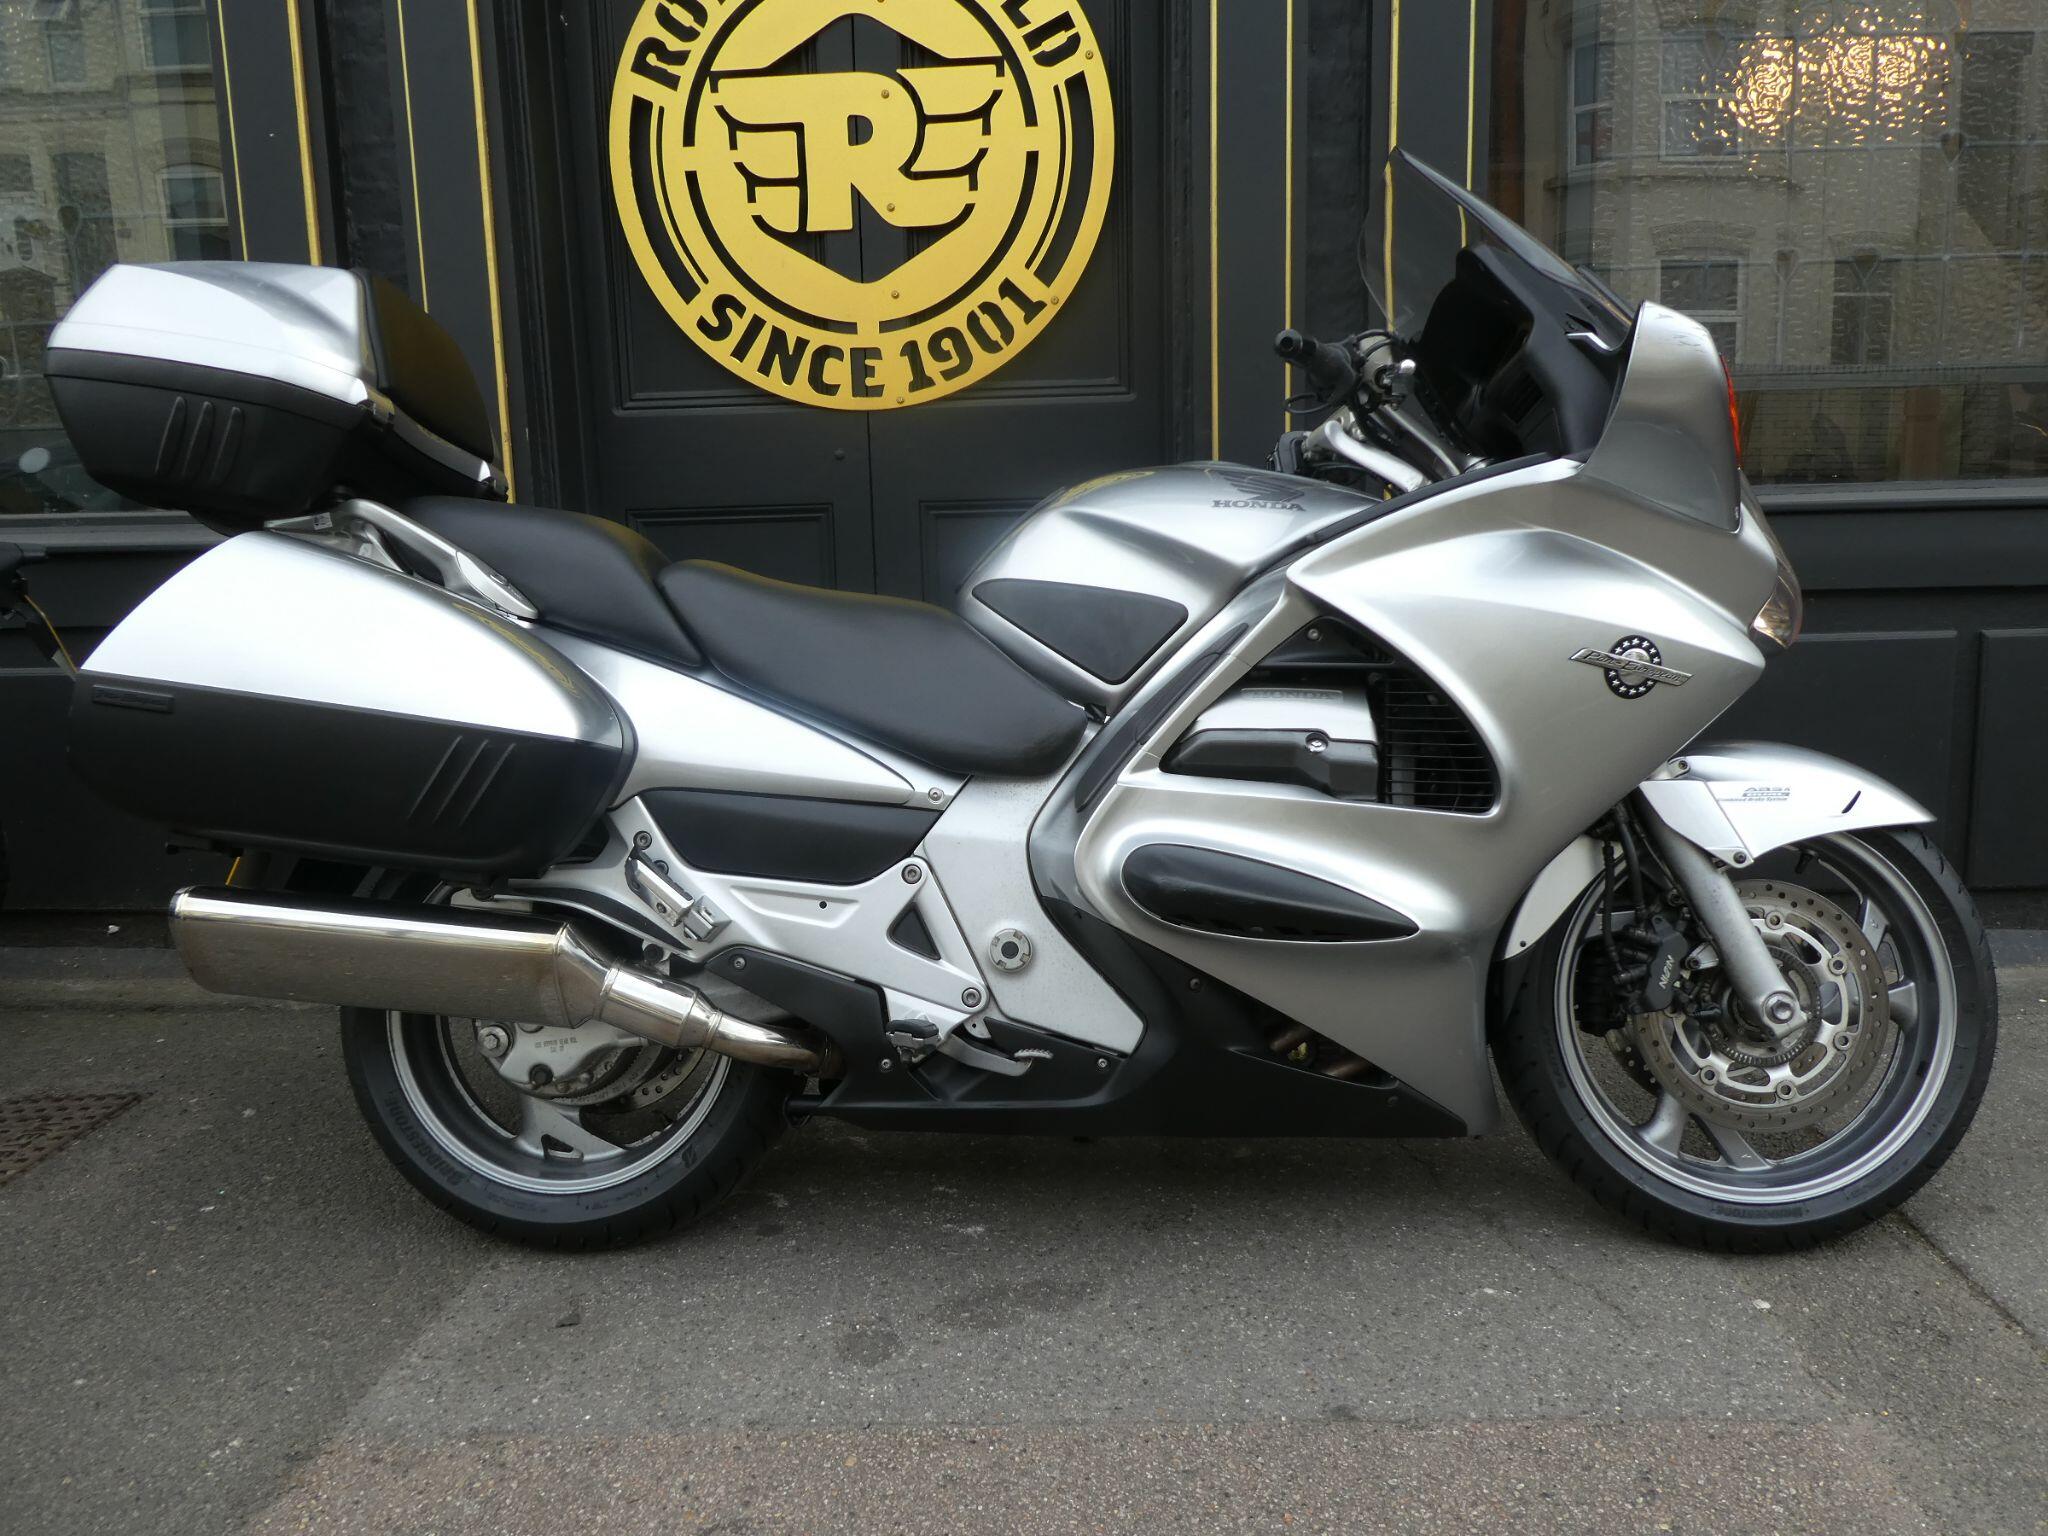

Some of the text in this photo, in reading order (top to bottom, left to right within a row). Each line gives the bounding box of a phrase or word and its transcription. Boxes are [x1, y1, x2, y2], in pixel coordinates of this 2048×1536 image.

[697, 276, 1047, 398] SINCE 1901
[1212, 499, 1306, 512] HONDA
